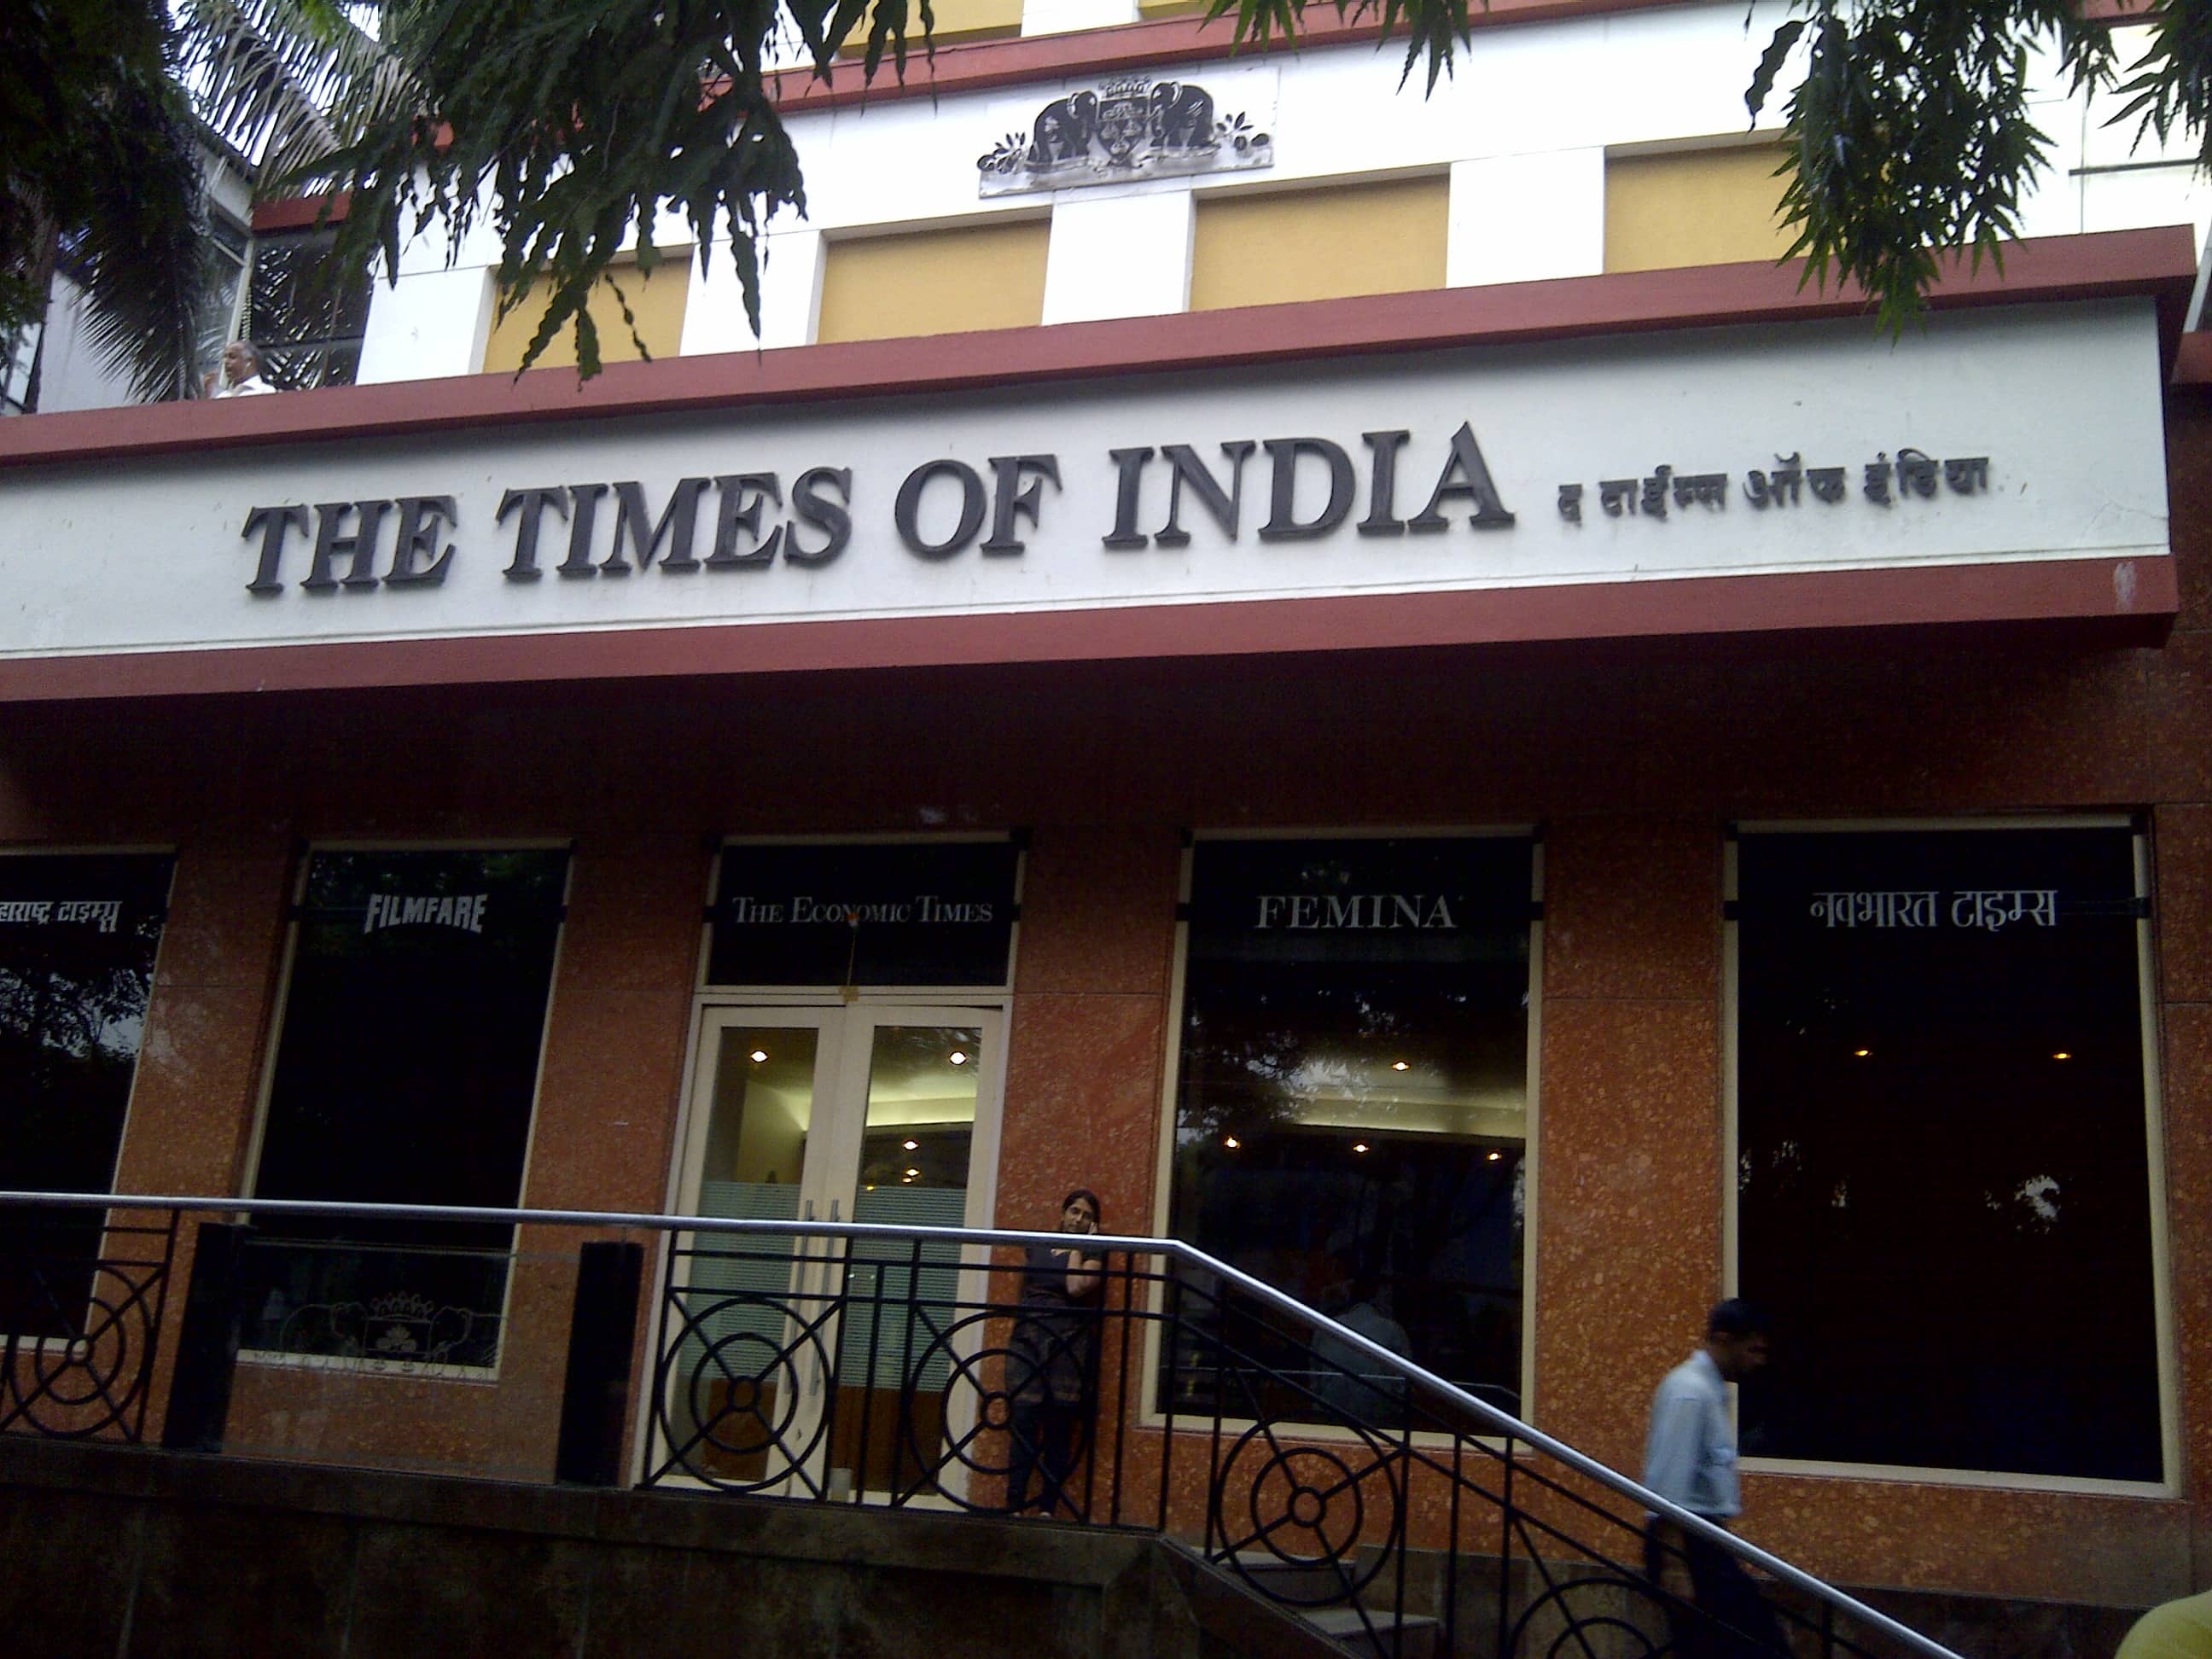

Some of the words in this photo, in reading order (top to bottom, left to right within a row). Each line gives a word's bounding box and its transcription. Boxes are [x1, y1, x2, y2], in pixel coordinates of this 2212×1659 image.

[1557, 483, 1583, 524] द
[1598, 463, 1728, 521] टाईम्स
[1743, 451, 1846, 510] ऑफ
[1862, 447, 1990, 505] इंडिया
[241, 495, 458, 601] THE
[495, 467, 853, 586] TIMES
[894, 454, 1063, 563] OF
[1102, 421, 1516, 552] INDIA
[0, 900, 55, 927] हाराष्ट्र
[364, 893, 488, 934] FILMFARE
[731, 896, 784, 923] THE
[789, 896, 911, 923] ECONOMIC
[914, 895, 995, 923] TIMES
[1254, 894, 1458, 929] FEMINA
[1809, 890, 1940, 928] नवभारत
[1949, 889, 2059, 933] टाइम्स
